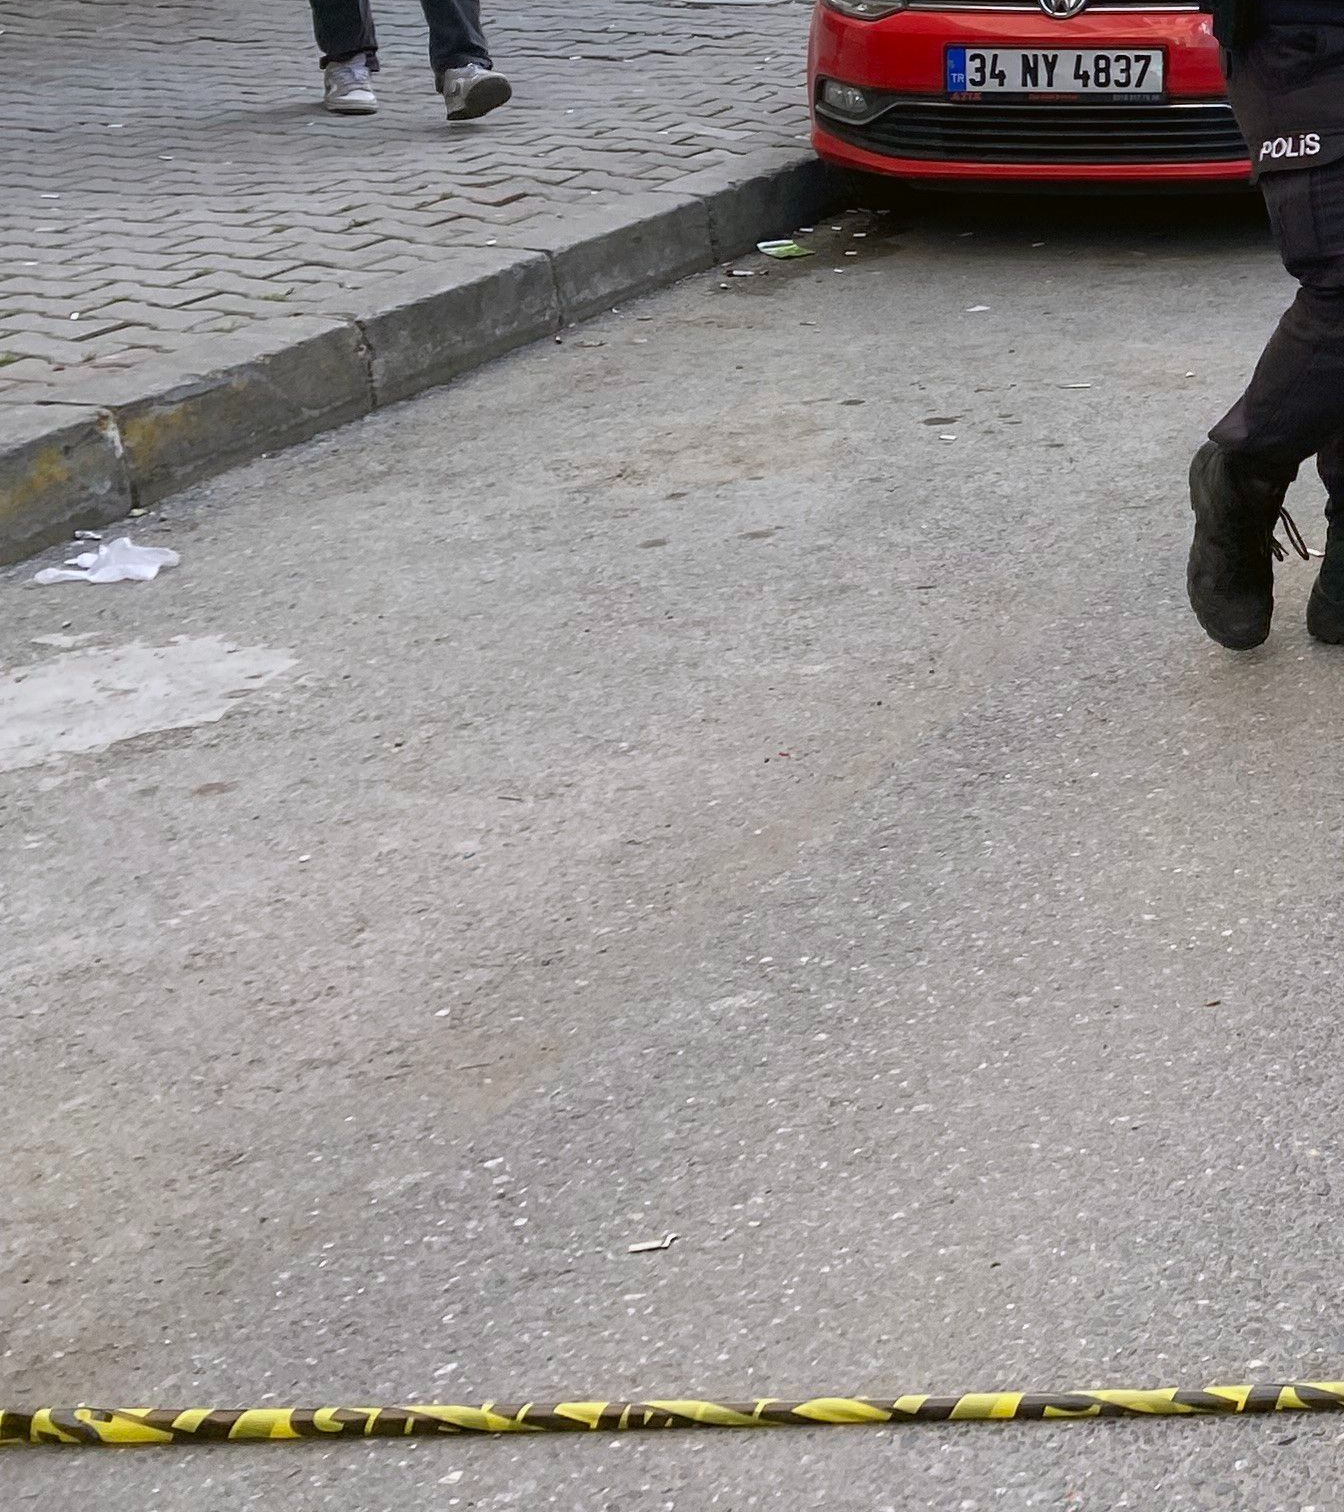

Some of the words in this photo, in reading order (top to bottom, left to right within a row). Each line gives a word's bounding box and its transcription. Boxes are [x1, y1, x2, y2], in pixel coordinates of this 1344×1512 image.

[951, 73, 965, 84] TR
[969, 53, 1007, 88] 34
[1021, 54, 1059, 88] NY
[1073, 54, 1152, 88] 4837
